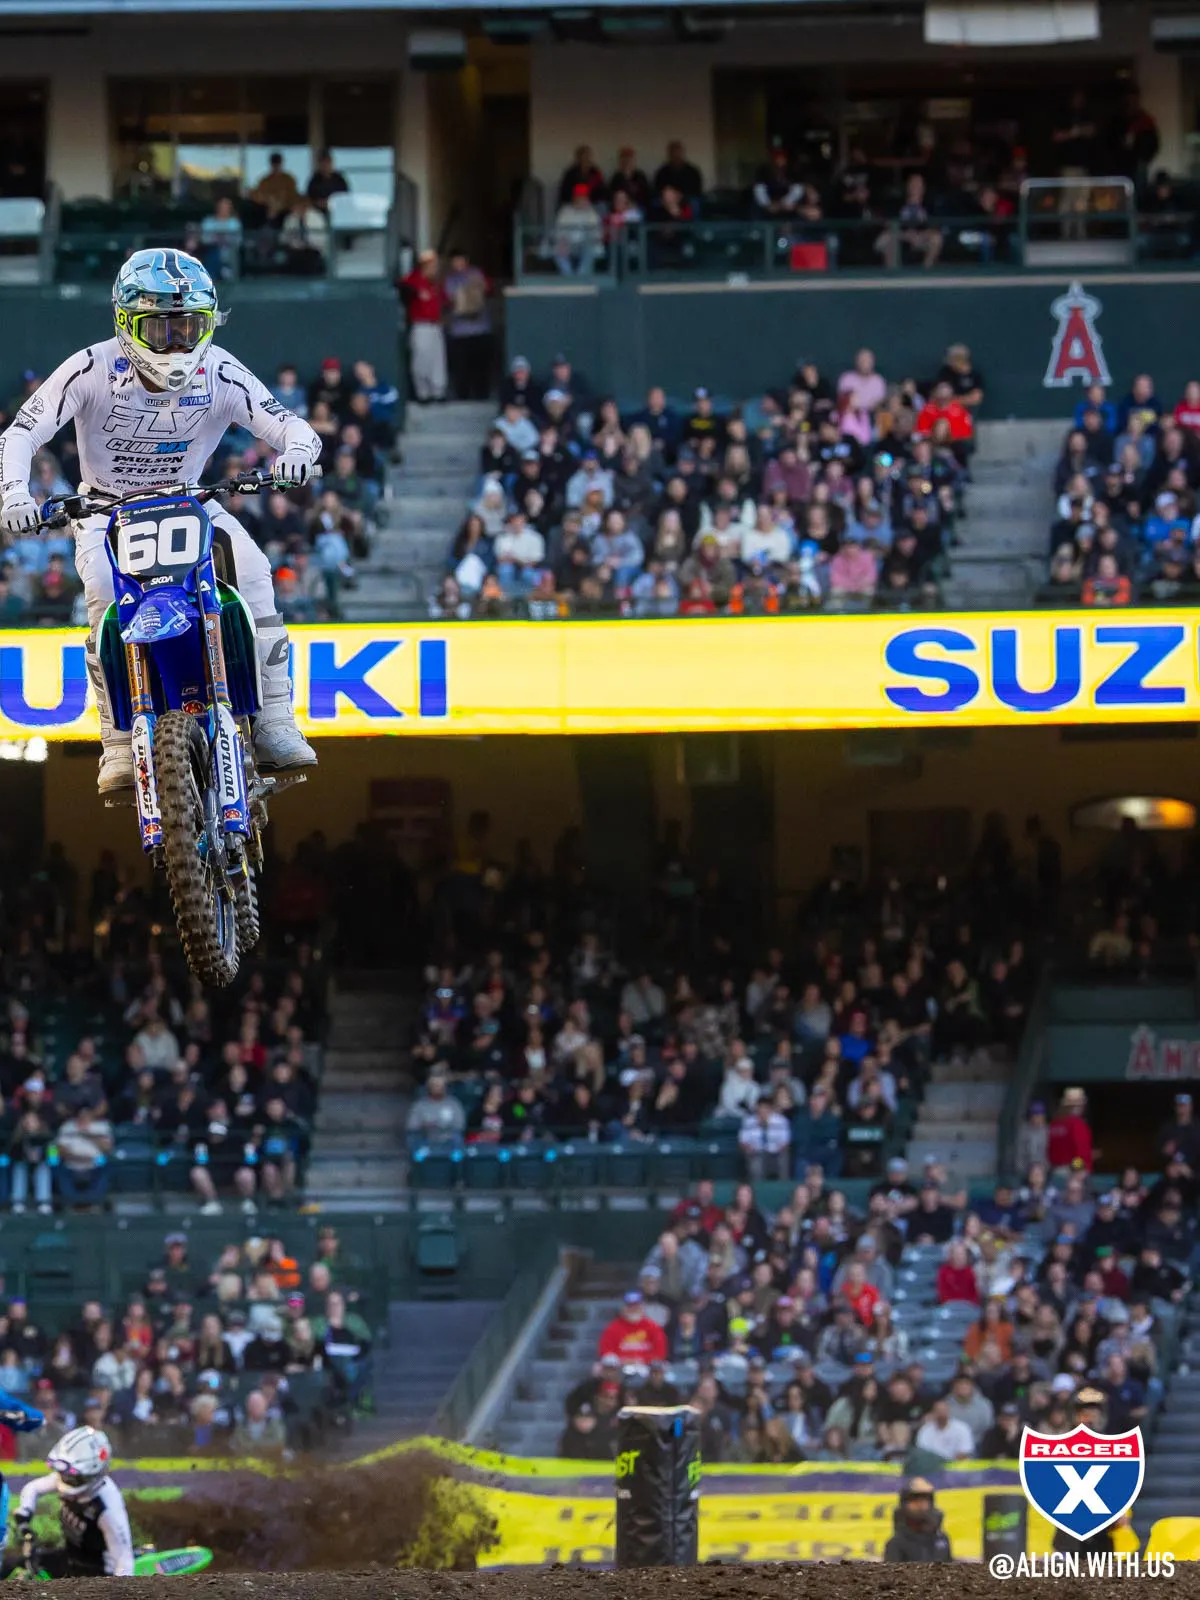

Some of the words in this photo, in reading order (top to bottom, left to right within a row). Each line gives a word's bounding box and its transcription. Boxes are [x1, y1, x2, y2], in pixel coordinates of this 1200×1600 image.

[103, 405, 209, 439] FLY
[111, 466, 183, 475] STUSSY
[112, 455, 185, 464] PAULSON
[118, 516, 201, 575] 60
[885, 626, 1200, 712] SUZ
[218, 727, 236, 800] DUNLOP
